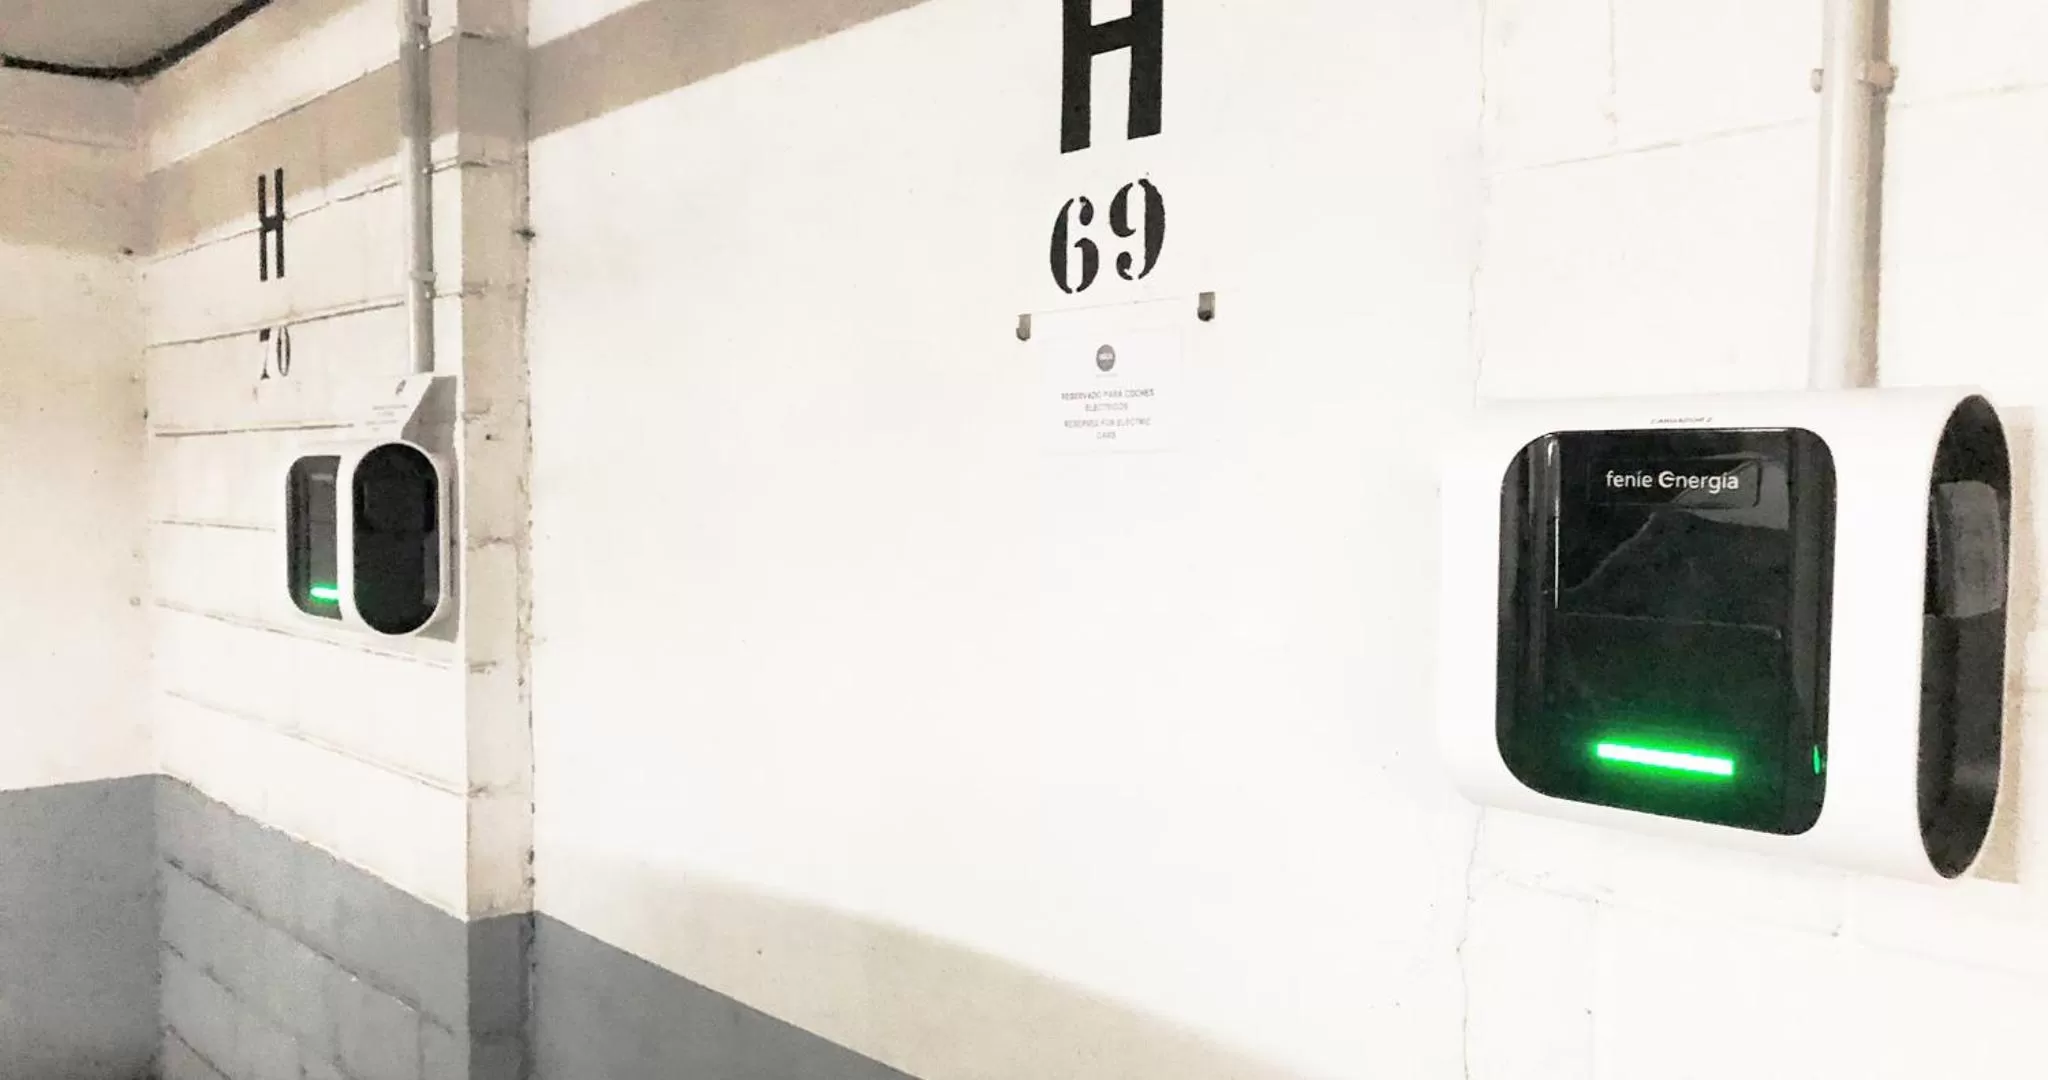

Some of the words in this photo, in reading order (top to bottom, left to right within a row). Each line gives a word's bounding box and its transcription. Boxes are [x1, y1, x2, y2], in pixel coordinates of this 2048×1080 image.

[1060, 0, 1163, 154] H
[258, 167, 285, 281] H
[1050, 178, 1166, 294] 69
[259, 325, 291, 380] 70
[1061, 390, 1101, 400] RESERVADO
[1103, 390, 1122, 398] PARA
[1125, 388, 1155, 398] COCHES
[1064, 419, 1098, 428] RESERVED
[1101, 419, 1115, 427] FOR
[1116, 418, 1151, 427] ELECTRIC
